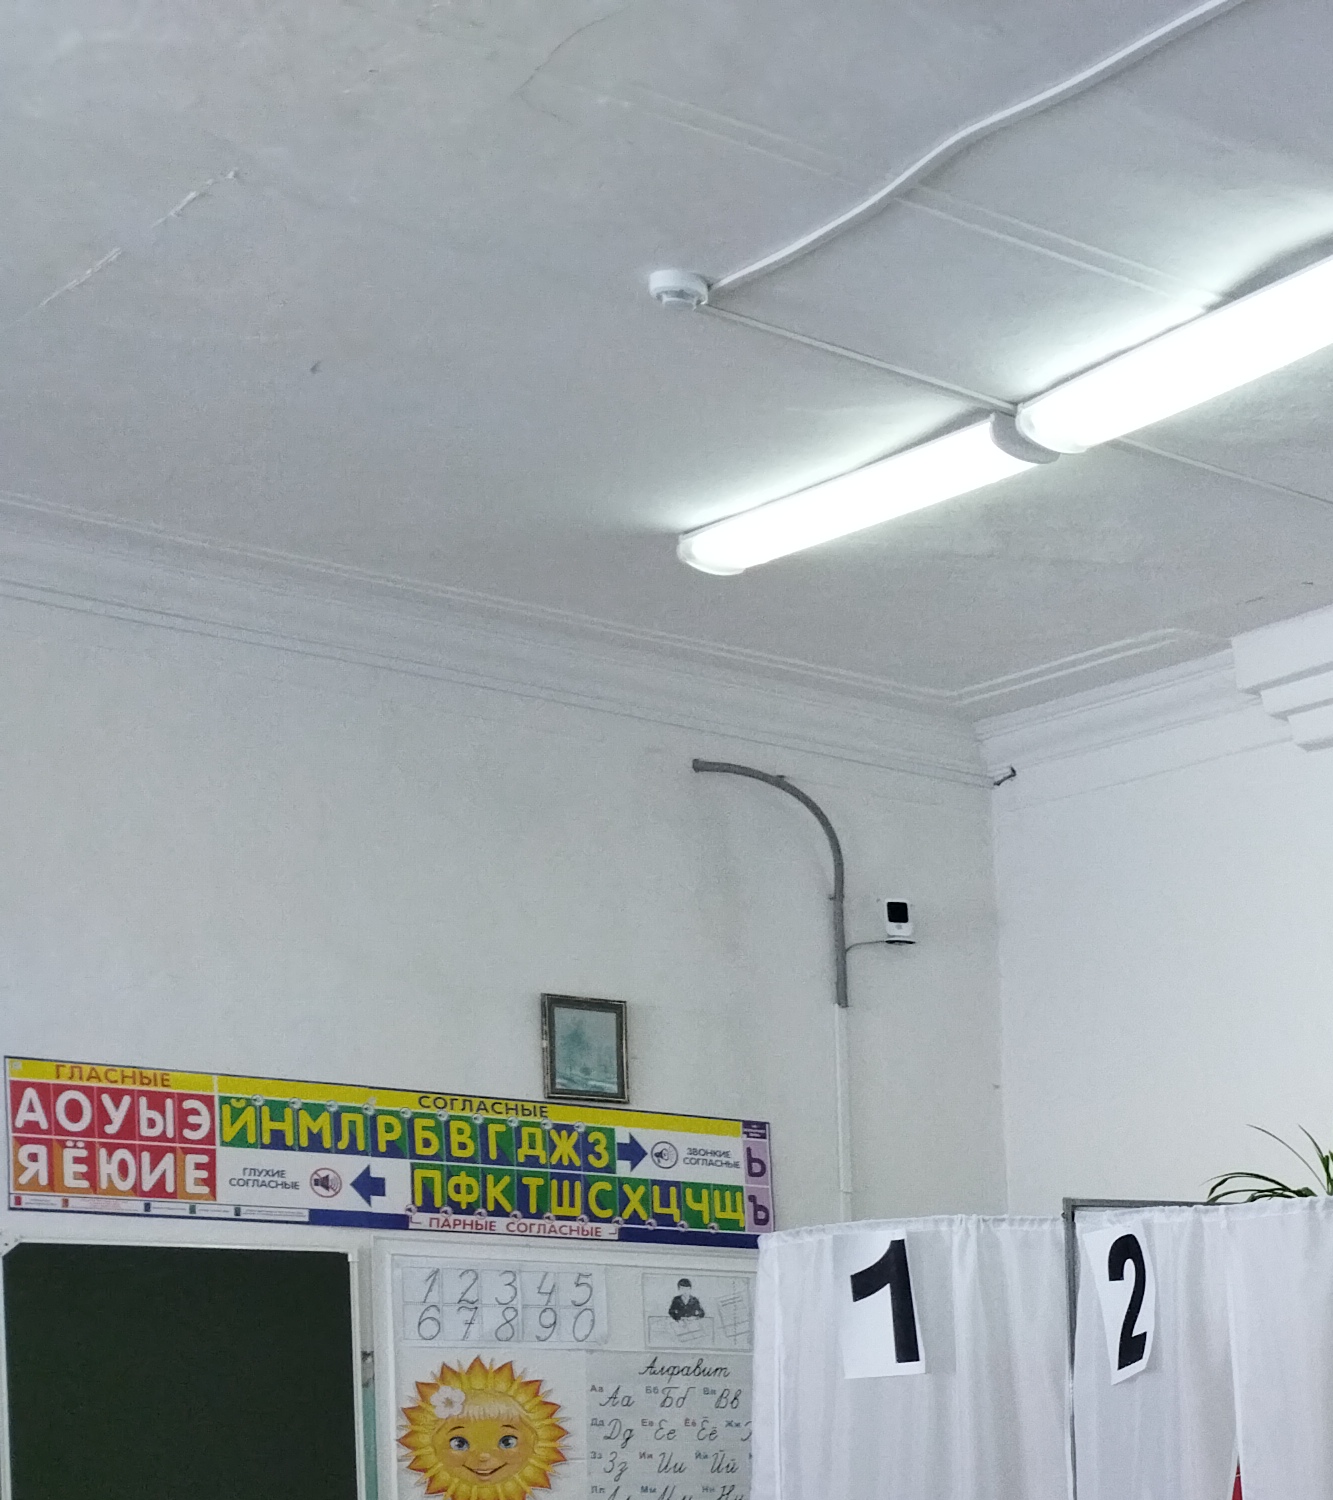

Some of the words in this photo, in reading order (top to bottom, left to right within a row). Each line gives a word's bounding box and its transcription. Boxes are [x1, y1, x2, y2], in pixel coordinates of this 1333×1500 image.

[55, 1064, 171, 1088] ГЛАСНЫЕ
[418, 1095, 549, 1119] СОГЛАСНЫЕ
[242, 1167, 286, 1179] ГЛУХИЕ
[683, 1157, 741, 1169] СОГЛАСНЫЕ
[229, 1177, 300, 1190] СОГЛАСНЫЕ
[429, 1216, 497, 1232] ПАРНЫЕ
[506, 1222, 602, 1238] СОГЛАСНЫЕ
[424, 1268, 440, 1303] 1
[457, 1269, 479, 1305] 2
[495, 1270, 517, 1305] 3
[537, 1271, 555, 1306] 4
[571, 1272, 593, 1306] 5
[850, 1238, 920, 1363] 1
[1107, 1233, 1147, 1371] 2
[418, 1305, 441, 1340] 6
[457, 1306, 478, 1341] 7
[495, 1306, 518, 1342] 8
[535, 1308, 557, 1342] 9
[573, 1308, 595, 1342] 0
[638, 1356, 731, 1384] Алфавит
